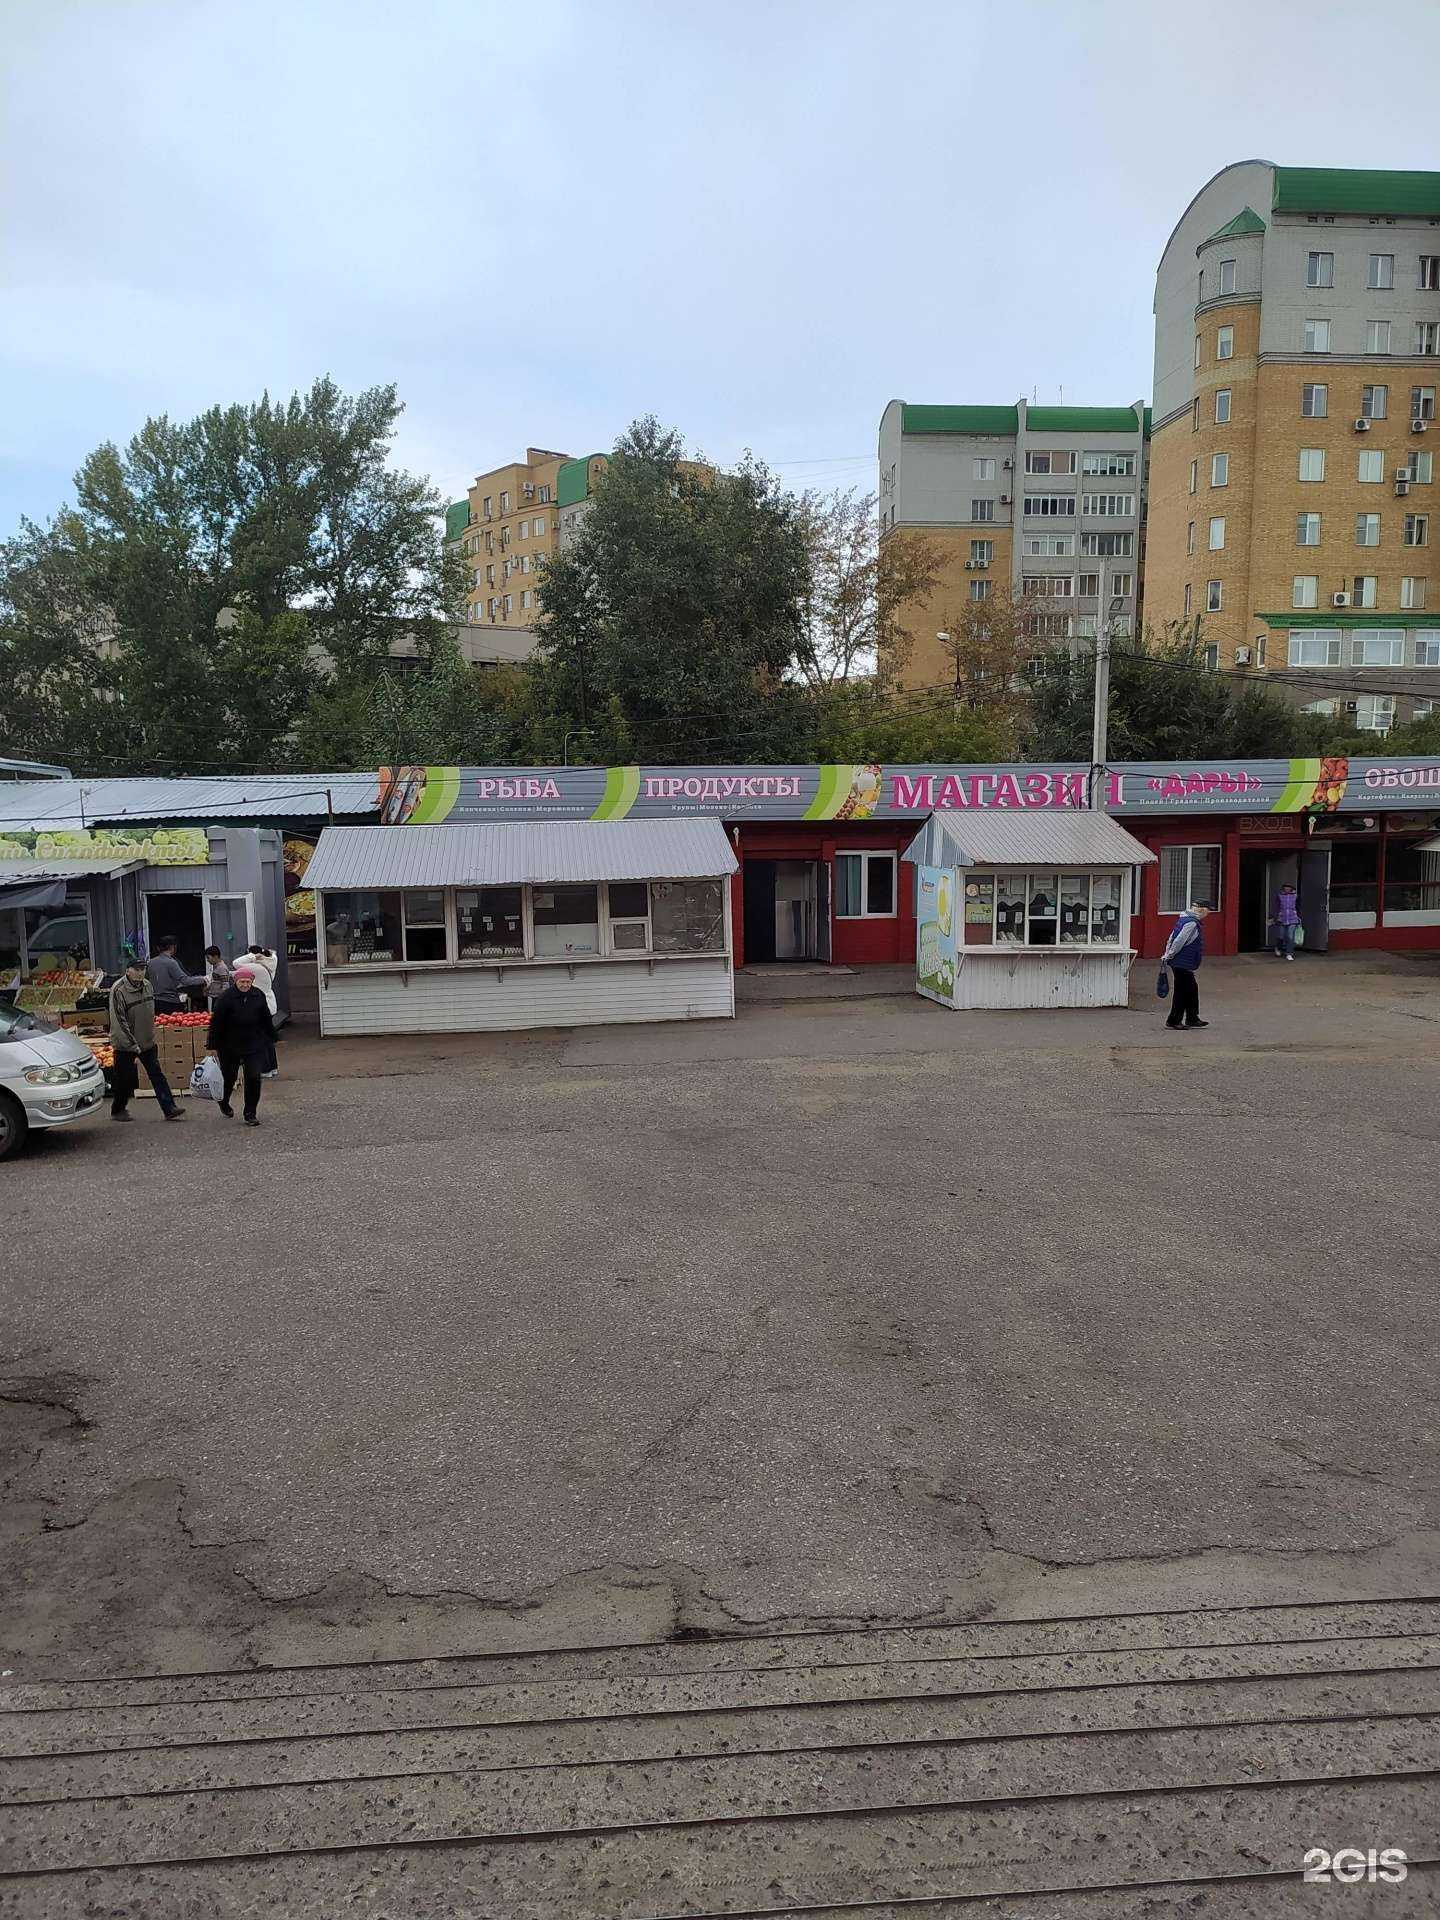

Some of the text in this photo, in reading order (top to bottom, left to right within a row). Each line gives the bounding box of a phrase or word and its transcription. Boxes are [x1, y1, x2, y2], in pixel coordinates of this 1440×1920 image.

[478, 776, 561, 800] РЫБА
[645, 776, 801, 801] ПРОДУКТЫ
[1239, 816, 1294, 831] ВХОД
